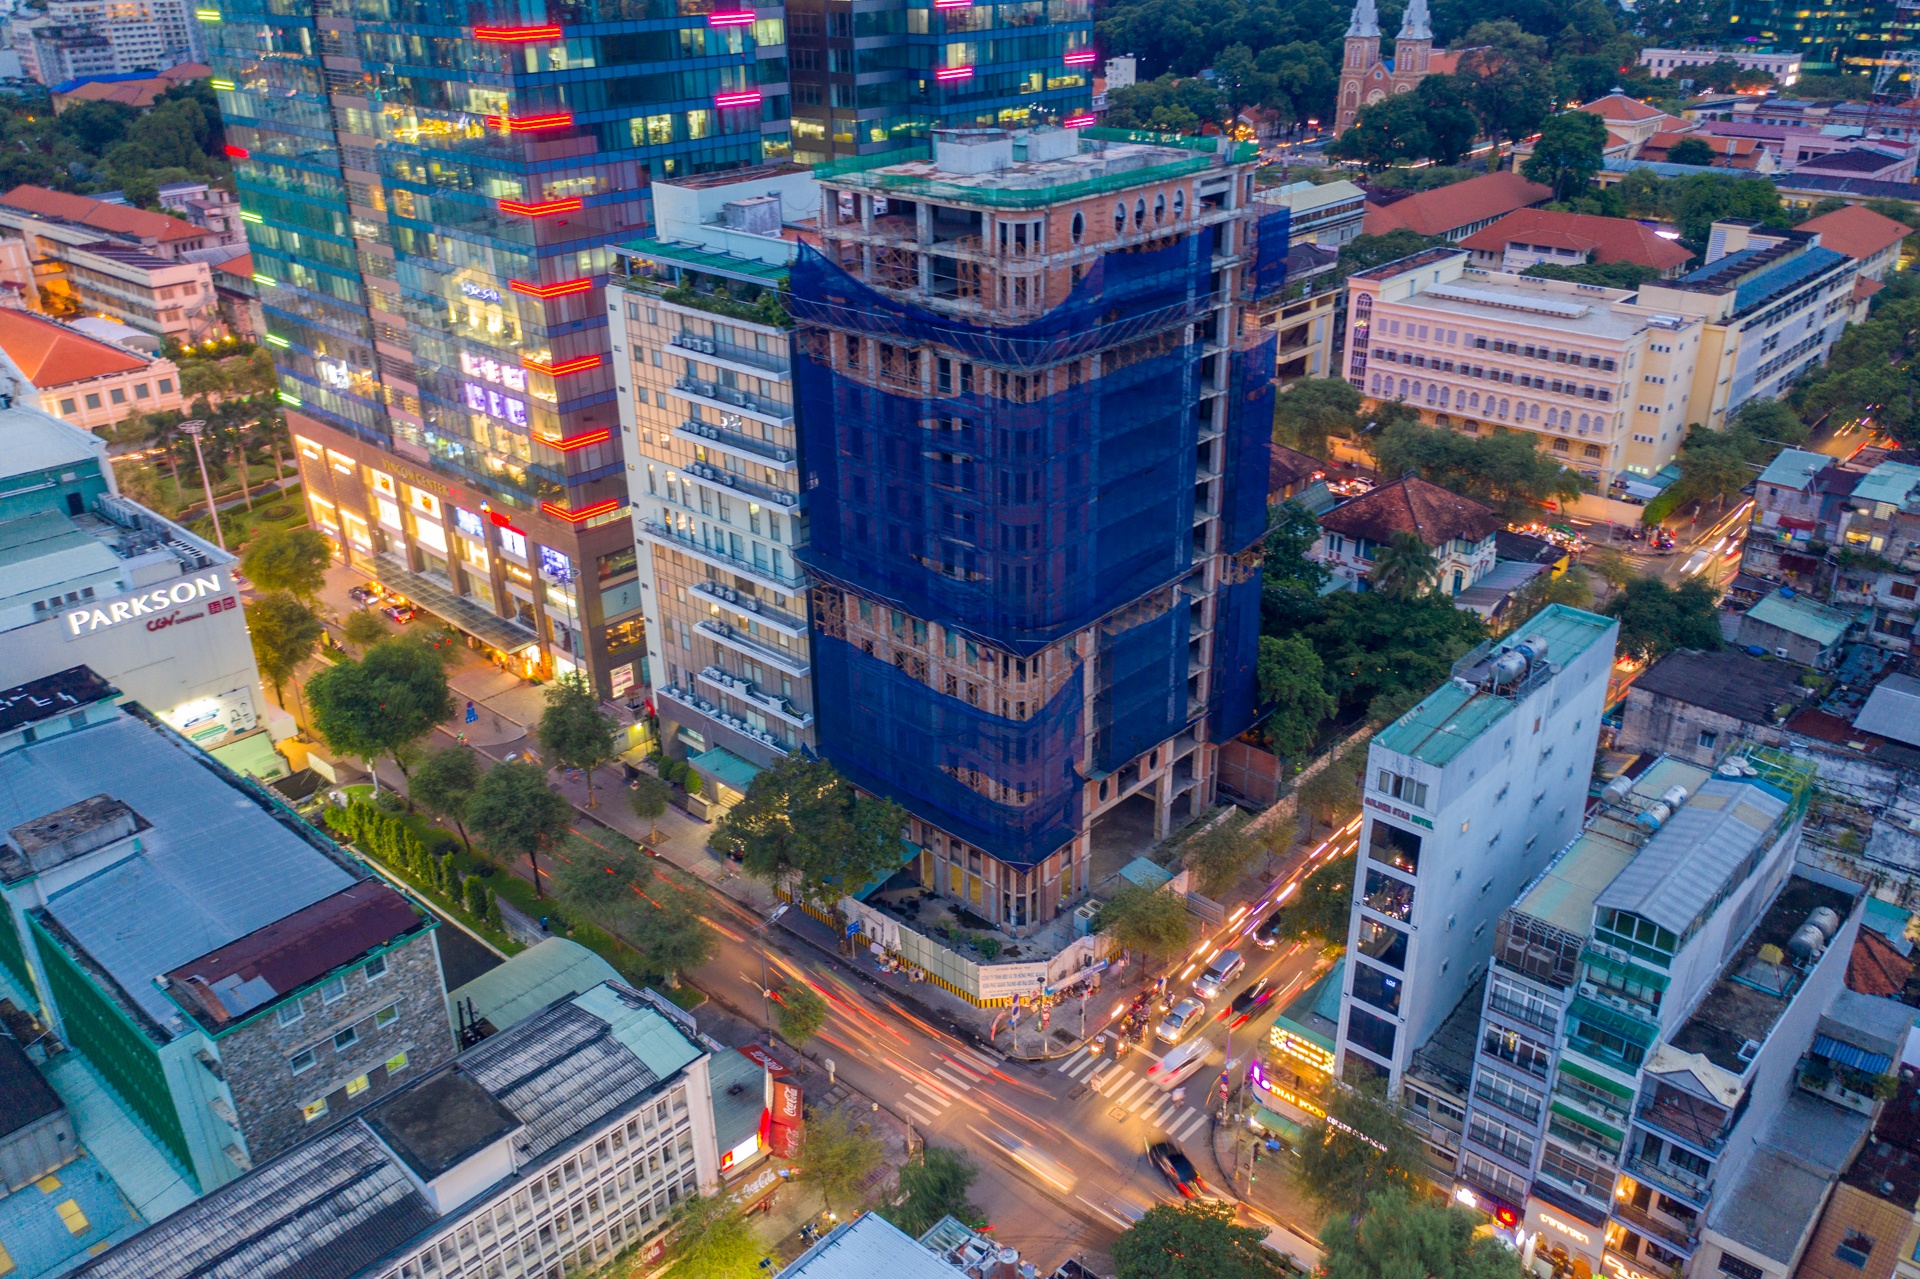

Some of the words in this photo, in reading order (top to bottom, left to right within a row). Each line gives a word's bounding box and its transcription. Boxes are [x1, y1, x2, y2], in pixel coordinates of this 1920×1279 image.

[382, 459, 416, 481] VINCOM
[416, 474, 447, 495] CENTER
[68, 574, 221, 635] PARKSON
[146, 614, 175, 632] CGV
[1393, 807, 1410, 820] STAR
[751, 1050, 783, 1071] Coca-Cla
[783, 1086, 798, 1117] Coca-Cola
[1270, 1084, 1295, 1103] THAI
[743, 1167, 777, 1199] Coca-Cola
